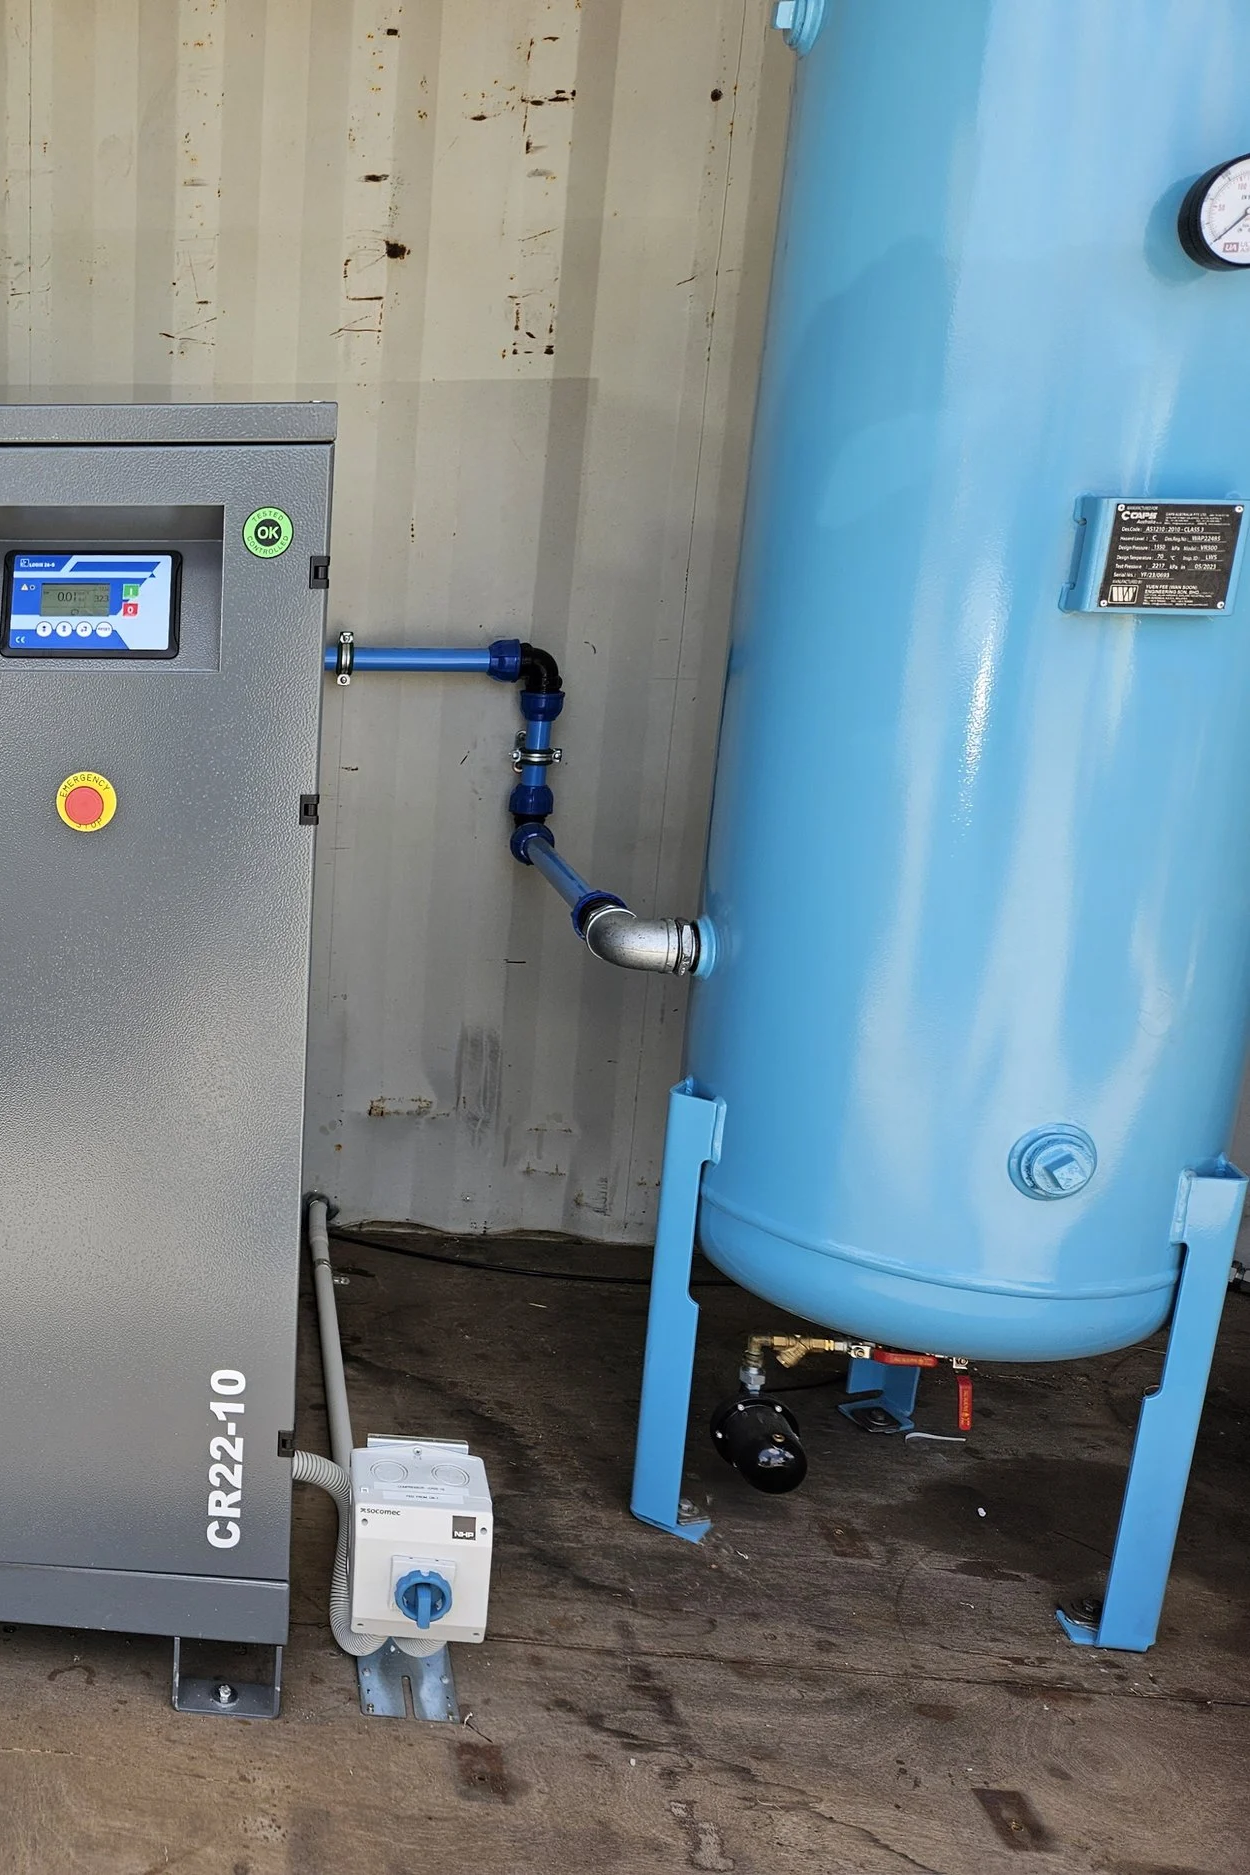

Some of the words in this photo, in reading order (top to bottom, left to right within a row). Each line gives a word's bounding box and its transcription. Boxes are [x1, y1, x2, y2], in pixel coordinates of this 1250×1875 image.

[252, 511, 284, 522] TESTED
[257, 526, 279, 540] OK
[246, 536, 289, 555] CONTROLLED
[60, 774, 111, 798] EMERGENCY
[206, 1369, 246, 1549] CR22-10
